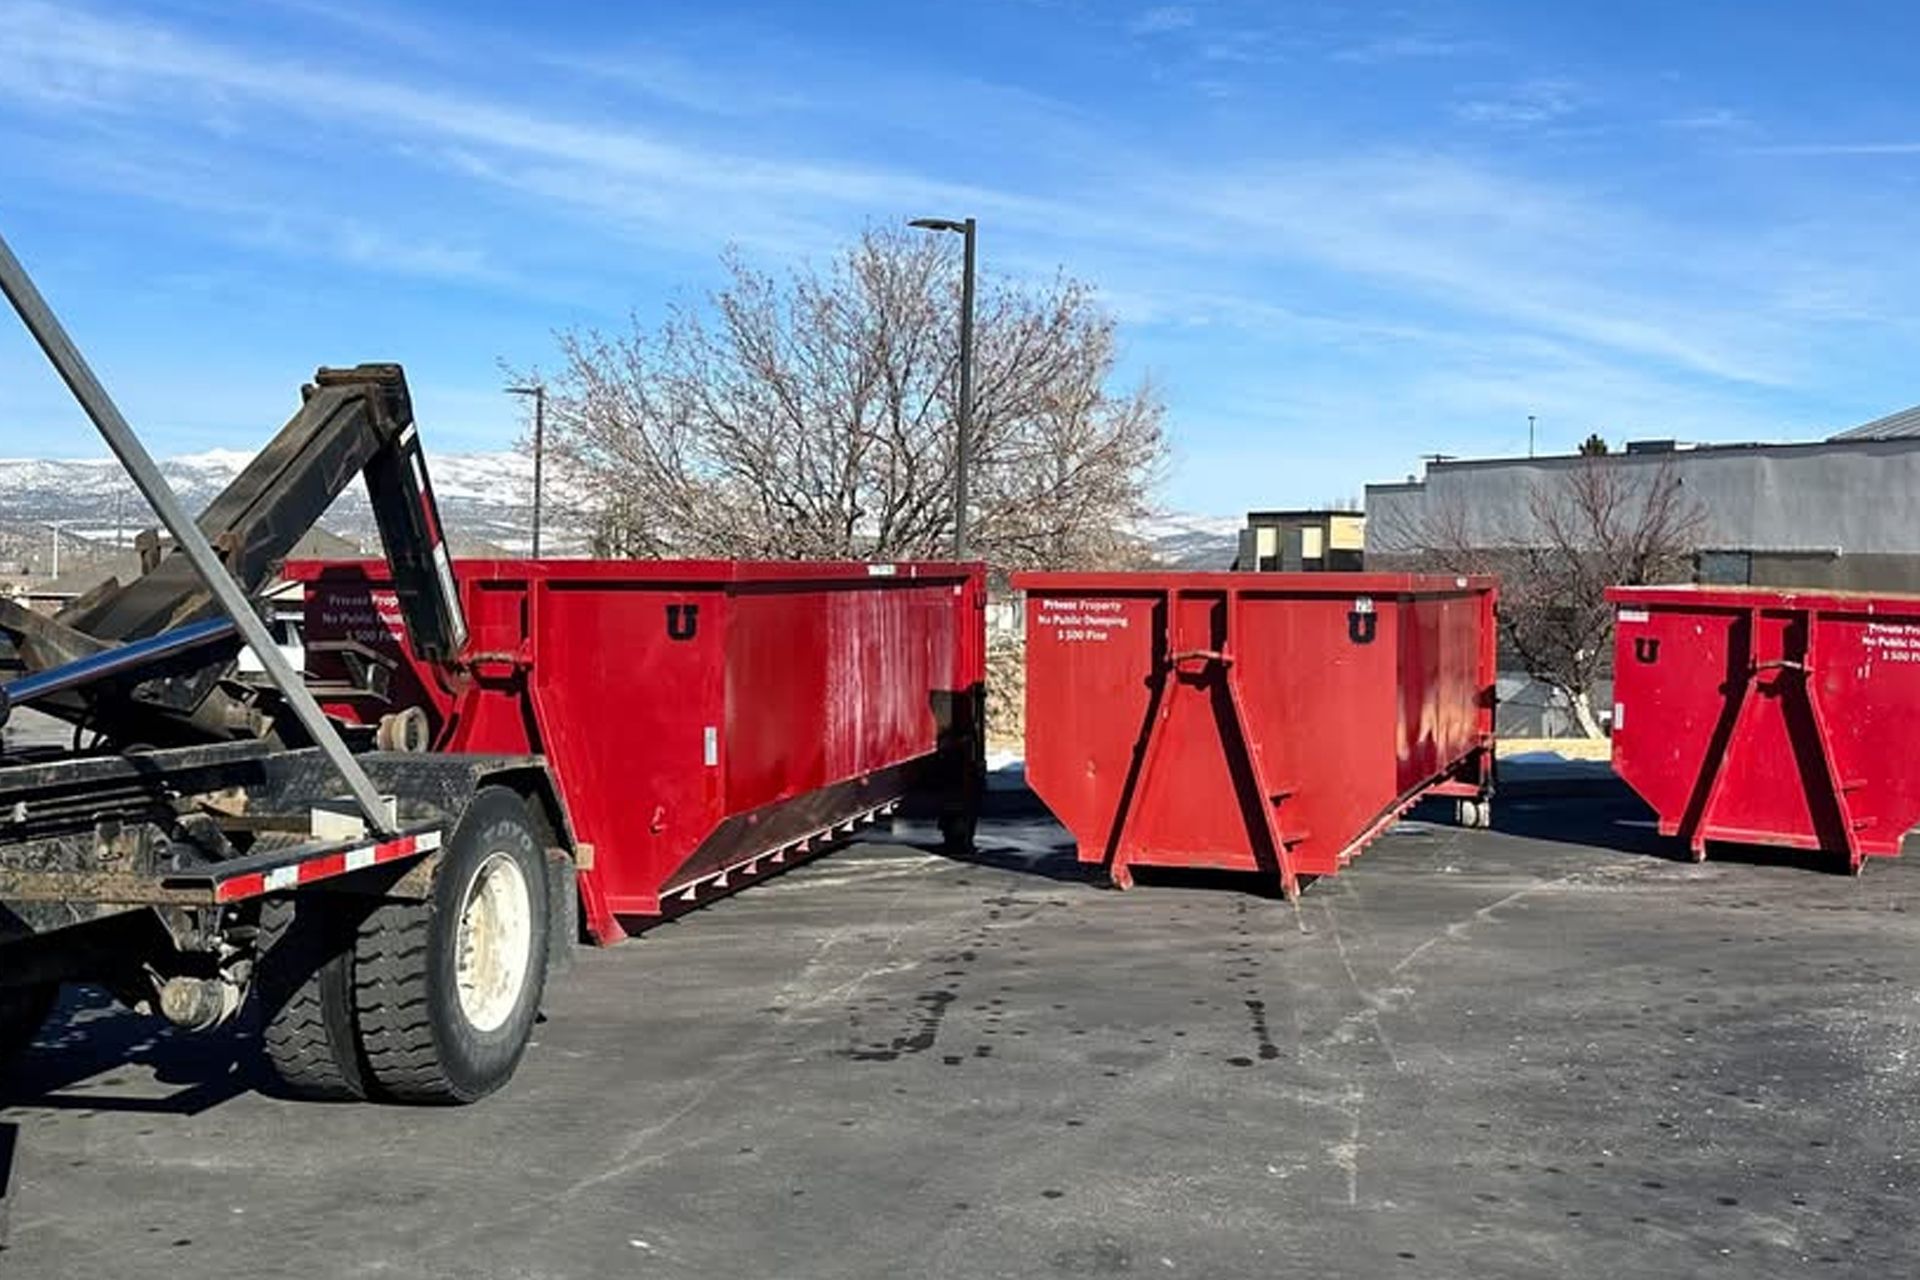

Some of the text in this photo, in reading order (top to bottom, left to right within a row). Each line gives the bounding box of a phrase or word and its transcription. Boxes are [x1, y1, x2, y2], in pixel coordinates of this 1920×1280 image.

[1079, 600, 1121, 612] Property
[666, 604, 699, 641] U
[1052, 615, 1081, 625] Public
[1082, 615, 1128, 628] Dumping
[1348, 612, 1378, 644] U
[1635, 637, 1660, 664] U
[1878, 637, 1908, 648] Public
